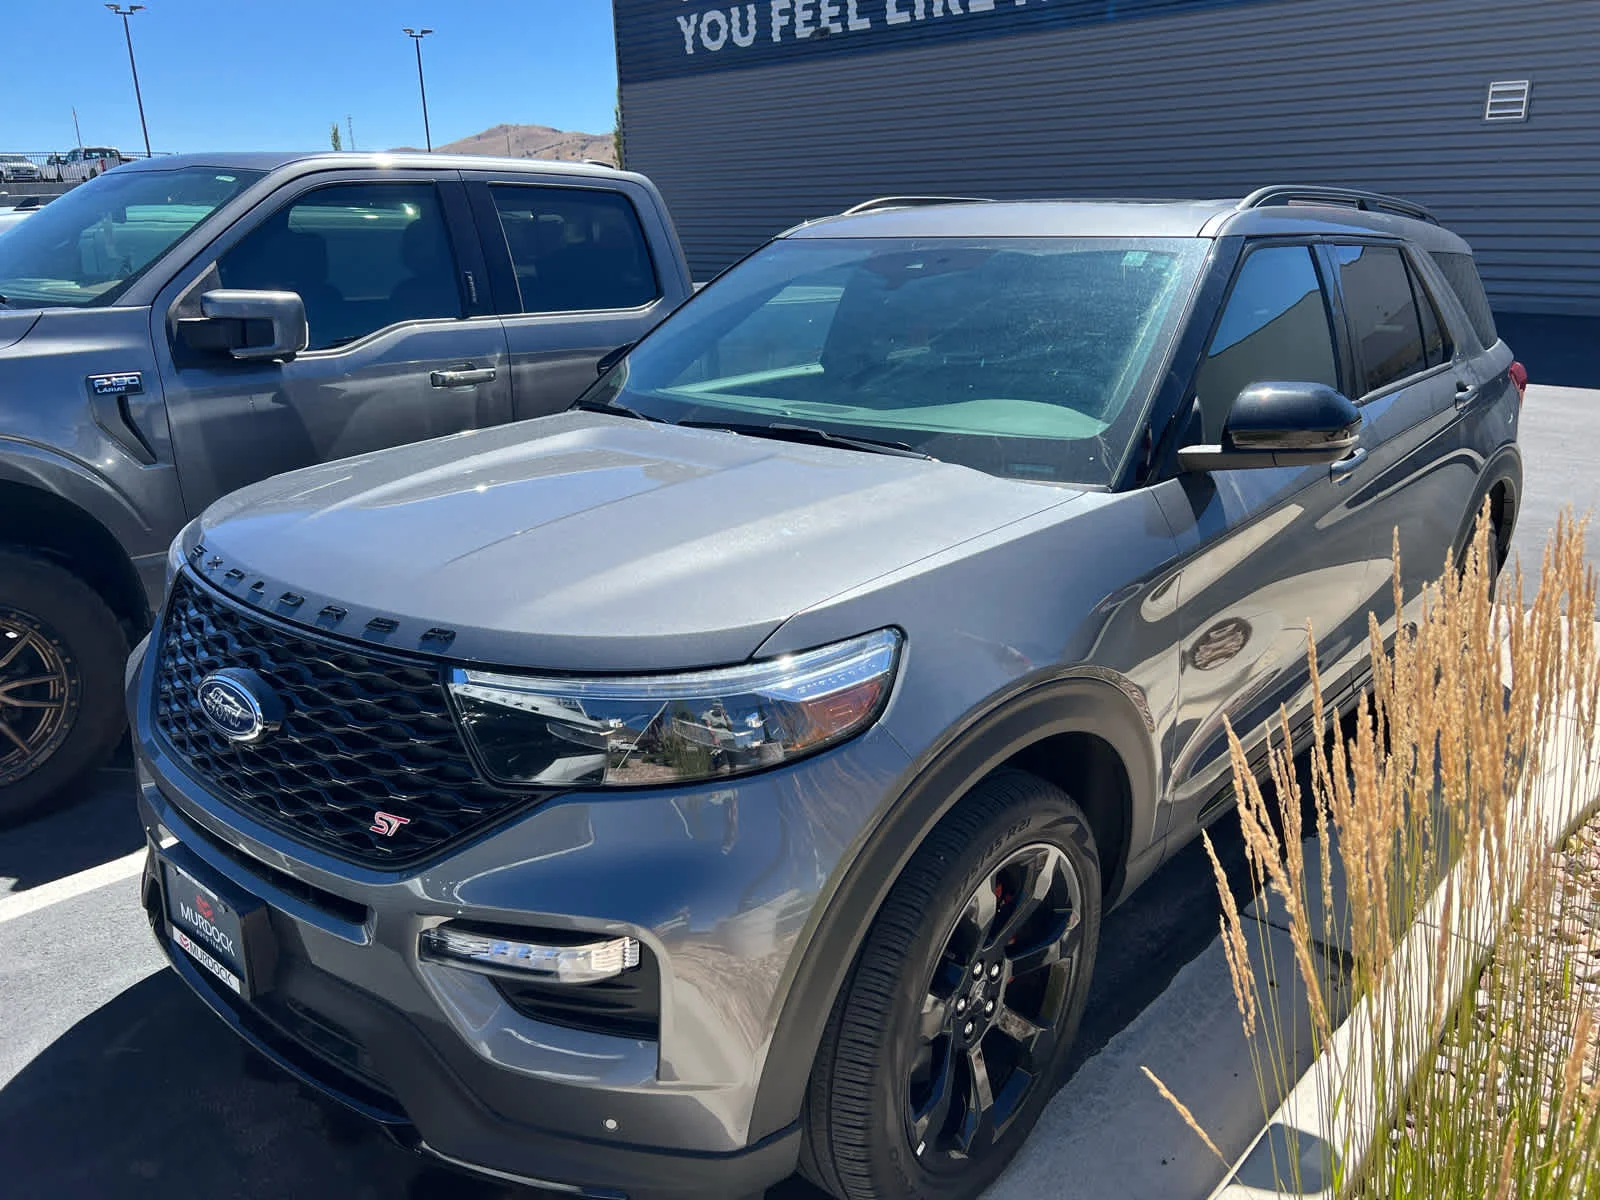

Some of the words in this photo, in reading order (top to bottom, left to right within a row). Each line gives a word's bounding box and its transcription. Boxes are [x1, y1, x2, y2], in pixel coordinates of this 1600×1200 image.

[676, 4, 757, 54] YOU
[770, 0, 870, 42] FEEL
[191, 543, 456, 642] EXPLORER
[369, 811, 411, 837] ST
[179, 901, 235, 957] MURDOCK
[190, 941, 233, 986] MURDOCK
